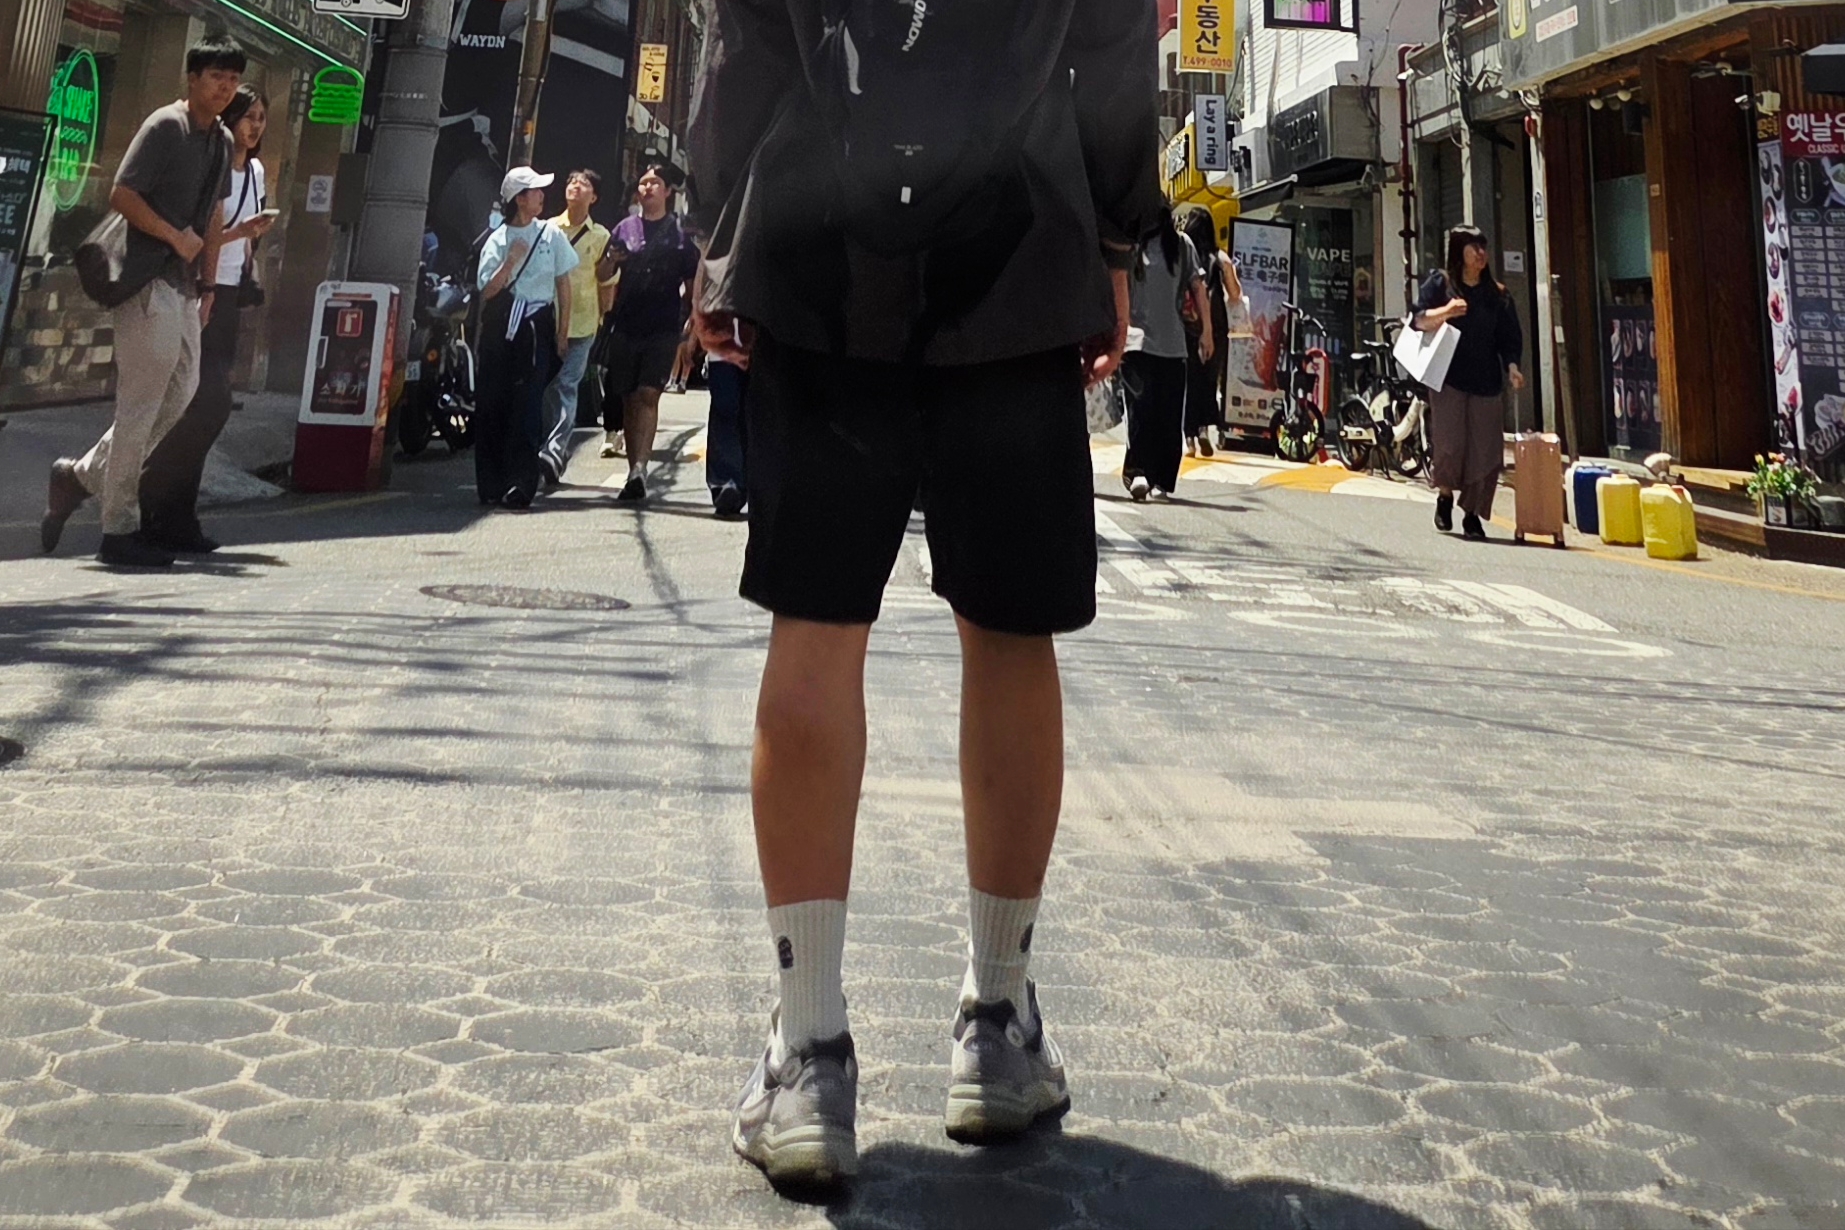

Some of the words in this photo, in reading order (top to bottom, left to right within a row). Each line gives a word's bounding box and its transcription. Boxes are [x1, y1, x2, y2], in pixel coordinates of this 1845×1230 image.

[1203, 99, 1218, 124] Lay
[1206, 127, 1216, 135] a
[1204, 137, 1218, 165] ring
[1807, 143, 1840, 154] CLASSIC
[1306, 246, 1352, 263] VAPE
